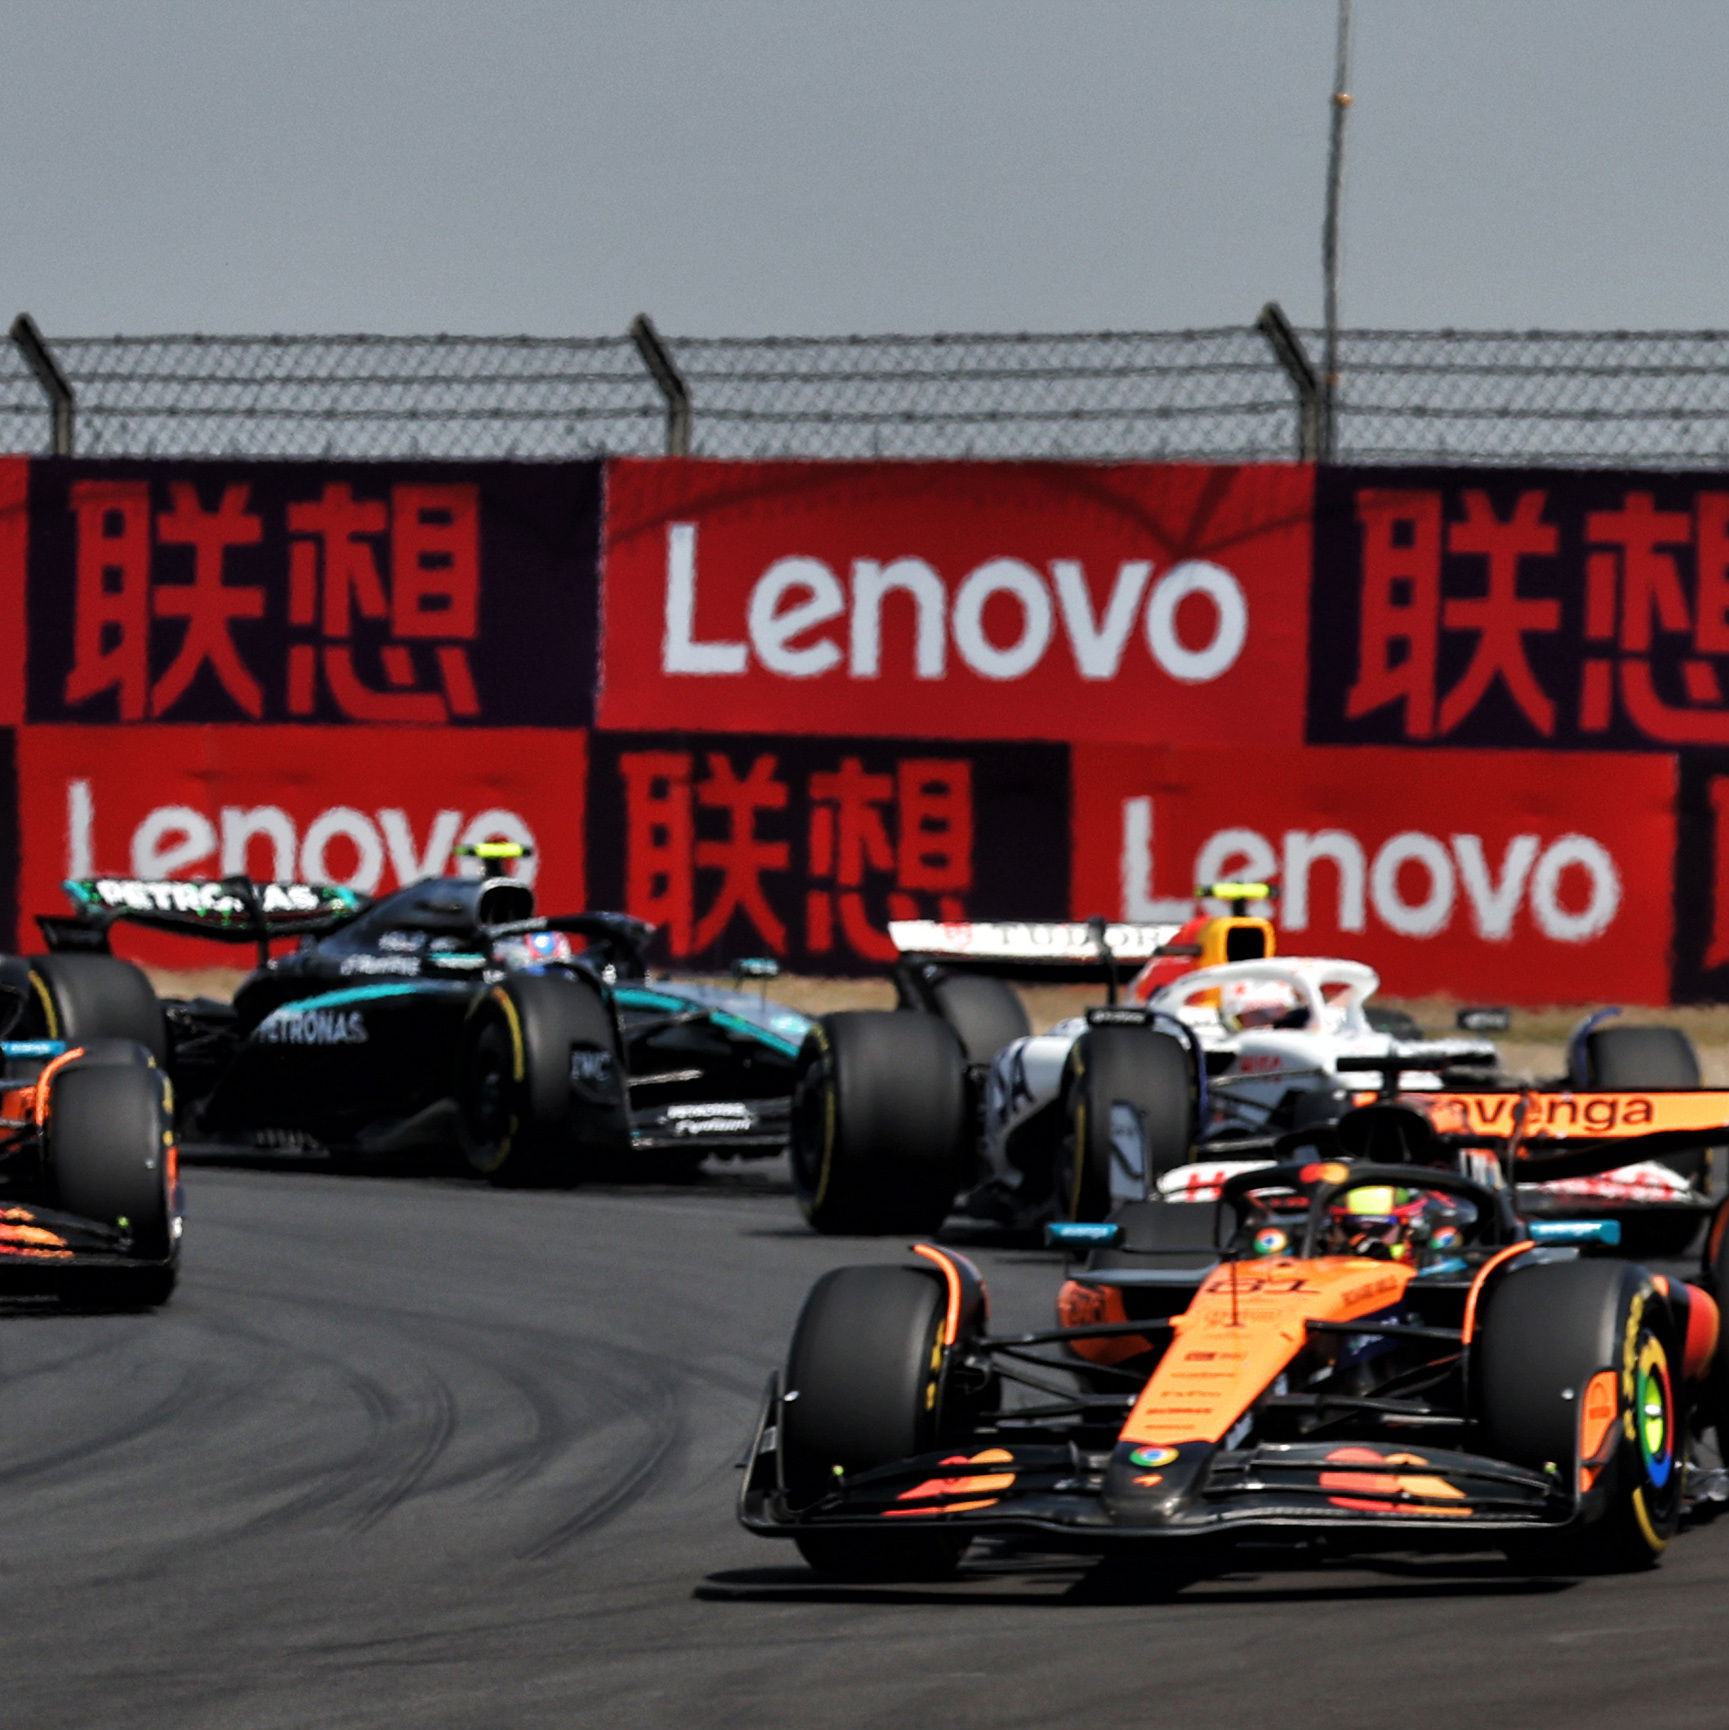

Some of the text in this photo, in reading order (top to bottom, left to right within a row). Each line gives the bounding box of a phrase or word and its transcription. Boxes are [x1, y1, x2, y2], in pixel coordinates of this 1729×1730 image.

[65, 481, 480, 721] 联想
[663, 523, 1248, 681] Lenovo
[68, 780, 539, 890] Lenovo
[621, 753, 972, 962] 联想
[1122, 798, 1621, 941] Lenovo
